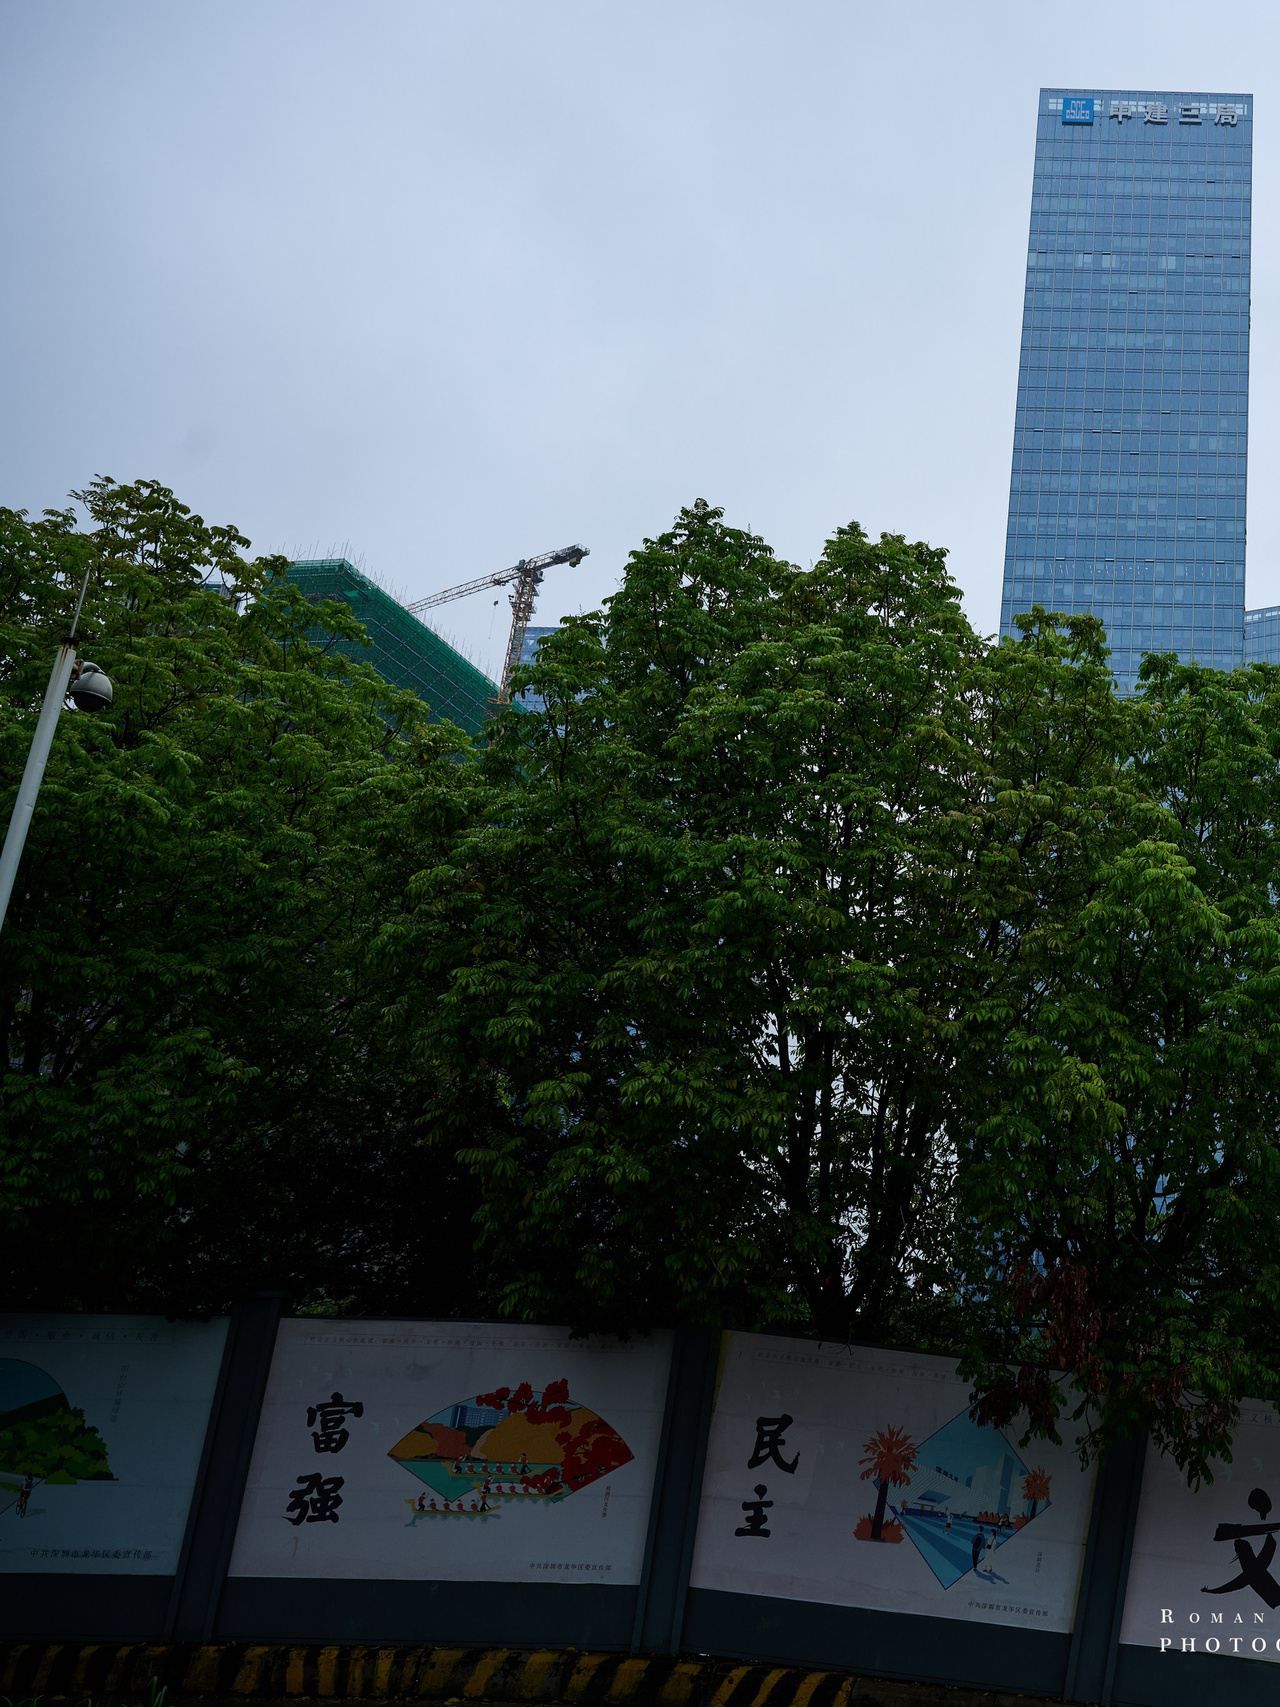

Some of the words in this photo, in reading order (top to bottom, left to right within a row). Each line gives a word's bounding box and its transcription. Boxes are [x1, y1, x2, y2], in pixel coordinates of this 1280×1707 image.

[1109, 102, 1238, 126] 中建三局
[281, 1392, 364, 1526] 富强
[735, 1413, 800, 1538] 民主
[30, 1549, 153, 1560] 中共深圳市龙华区委宣传部
[529, 1562, 612, 1571] 中共深圳市龙华区委宣传部
